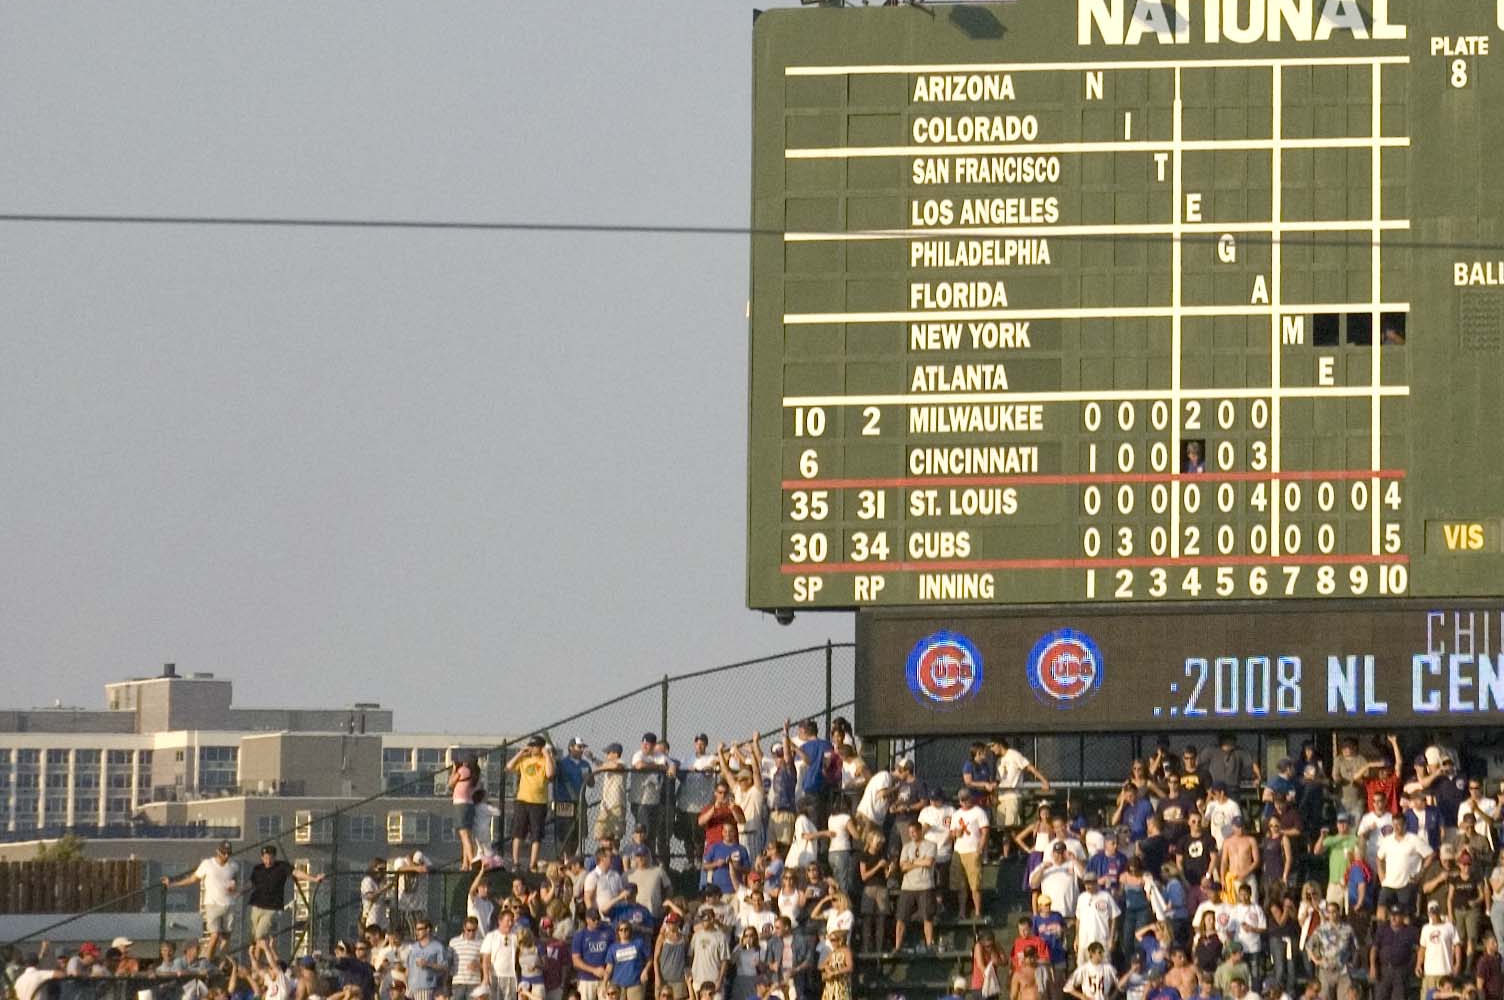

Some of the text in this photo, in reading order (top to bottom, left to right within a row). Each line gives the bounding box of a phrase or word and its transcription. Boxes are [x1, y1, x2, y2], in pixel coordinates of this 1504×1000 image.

[1430, 35, 1489, 56] PLATE
[913, 74, 1016, 102] ARIZONA
[1450, 58, 1468, 88] 8
[912, 114, 1039, 144] COLORADO
[912, 156, 1060, 185] SAN FRANCISCO
[911, 196, 1059, 226] LOS ANGELES
[911, 238, 1051, 268] PHILADELPHIA
[910, 281, 1008, 309] FLORIDA
[911, 321, 1031, 350] NEW YORK
[911, 364, 1009, 392] ATLANTA
[795, 398, 1268, 437] 10 2 MILWAUKEE 0 0 0 2 0 0
[799, 440, 1268, 479] 6 CINCINNATI 1 0 0 0 3
[790, 480, 1402, 521] 35 31 ST. LOUIS 0 0 0 0 0 4 0 0 0 4
[789, 523, 1401, 563] 30 34 CUBS 0 3 0 2 0 0 0 0 5
[1443, 523, 1484, 550] VIS
[793, 564, 1408, 602] SP RP INNING 1 2 3 4 5 6 7 8 9 10
[1327, 655, 1388, 713] NL
